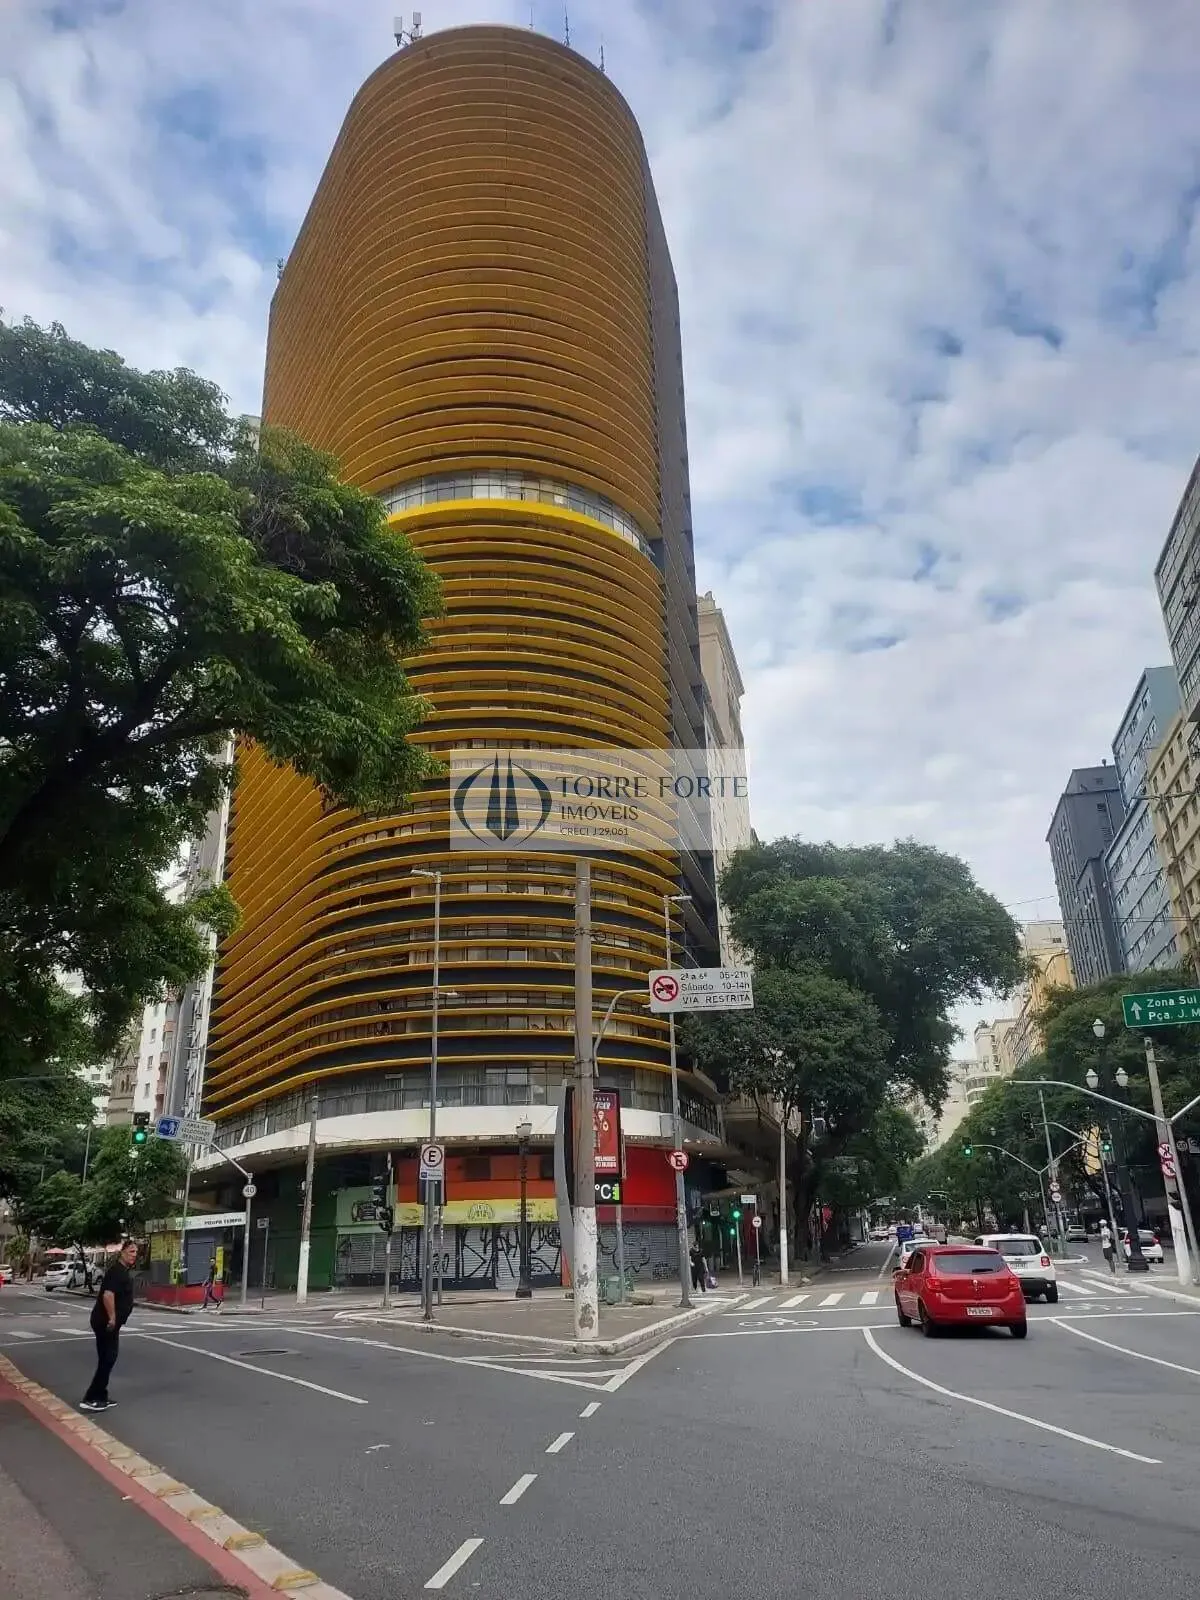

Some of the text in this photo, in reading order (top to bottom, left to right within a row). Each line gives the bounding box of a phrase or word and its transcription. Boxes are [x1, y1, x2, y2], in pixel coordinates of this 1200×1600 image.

[681, 983, 714, 991] Sábado
[682, 994, 751, 1004] VIA RESTRITA
[1147, 995, 1197, 1008] Zona Sul
[1177, 1009, 1188, 1018] J.
[428, 1150, 437, 1163] E
[244, 1186, 255, 1194] 40
[594, 1183, 611, 1199] °C
